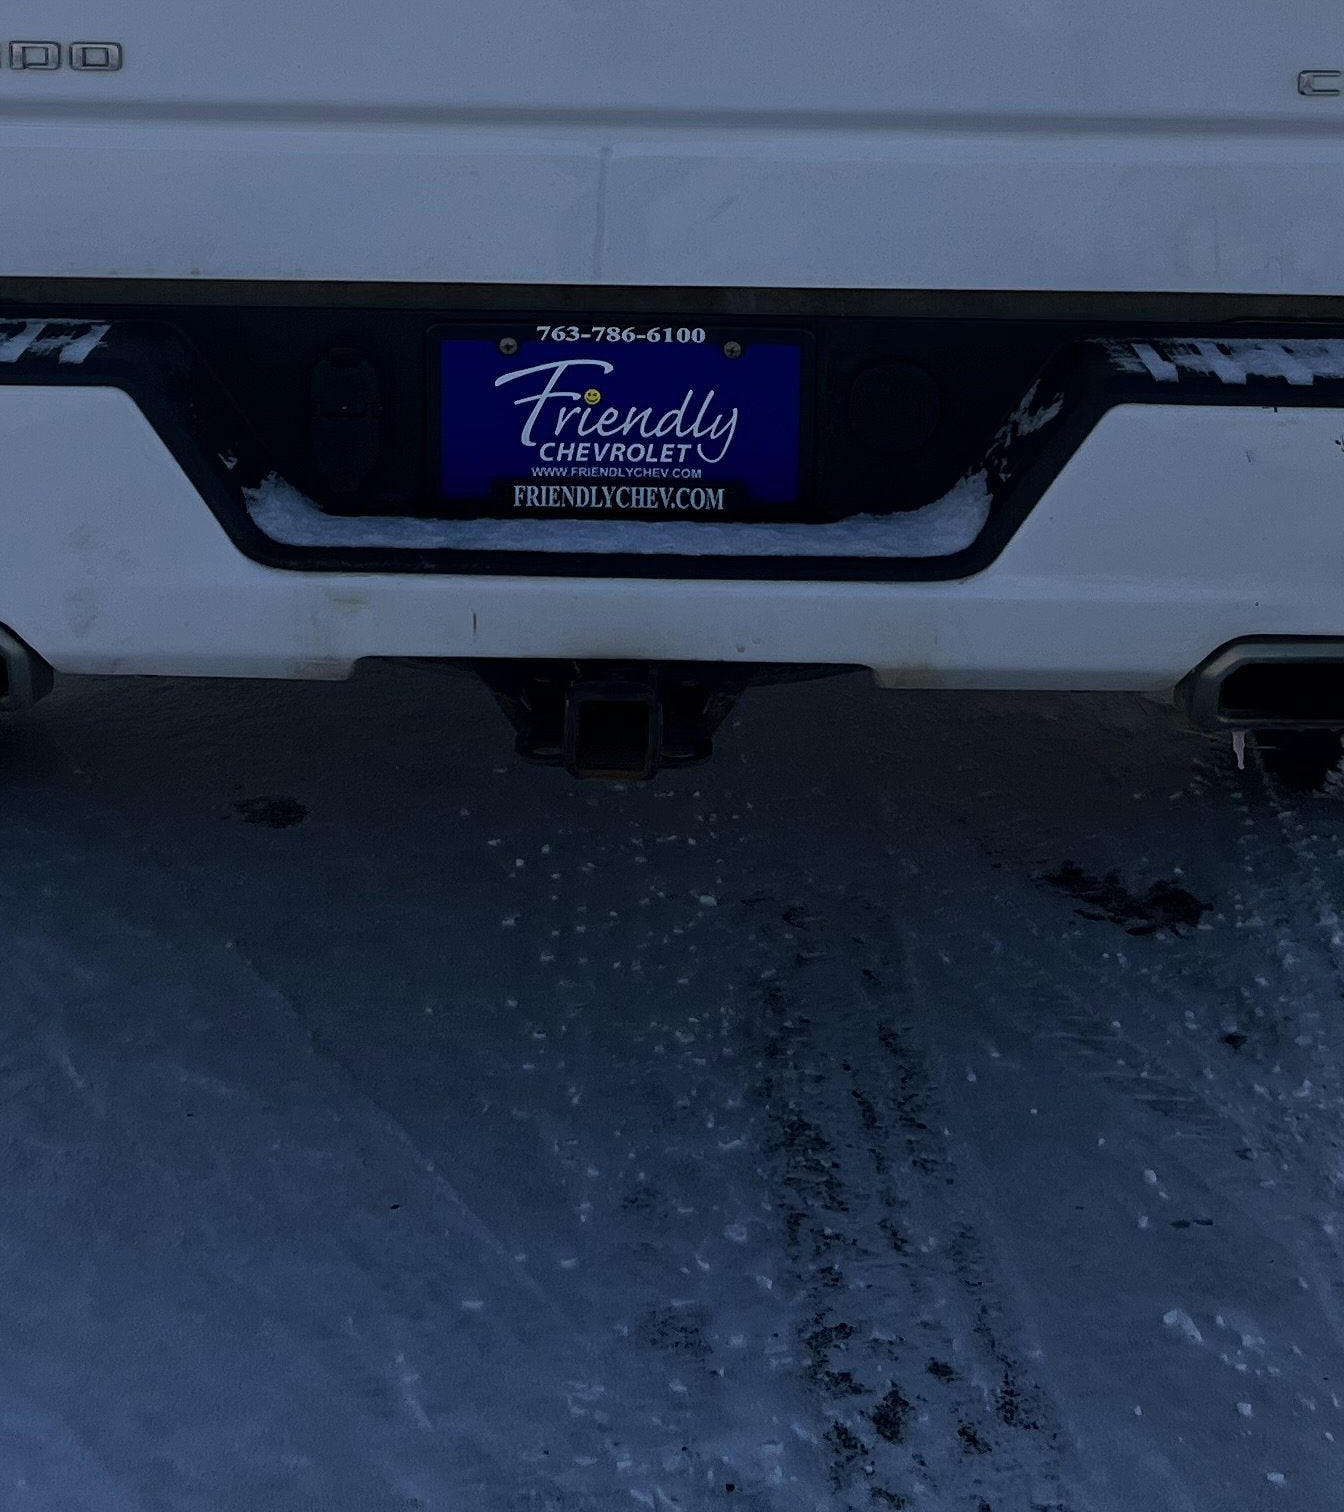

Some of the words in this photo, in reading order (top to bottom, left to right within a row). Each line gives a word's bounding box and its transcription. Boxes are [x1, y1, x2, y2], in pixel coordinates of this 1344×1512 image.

[536, 325, 706, 344] 763-786-6100
[494, 359, 738, 464] Friendly
[539, 441, 693, 464] CHEVROLET
[531, 466, 702, 479] WWW.FRIENDLYCHEV.COM
[513, 484, 726, 511] FRIENDLYCHEV.COM
